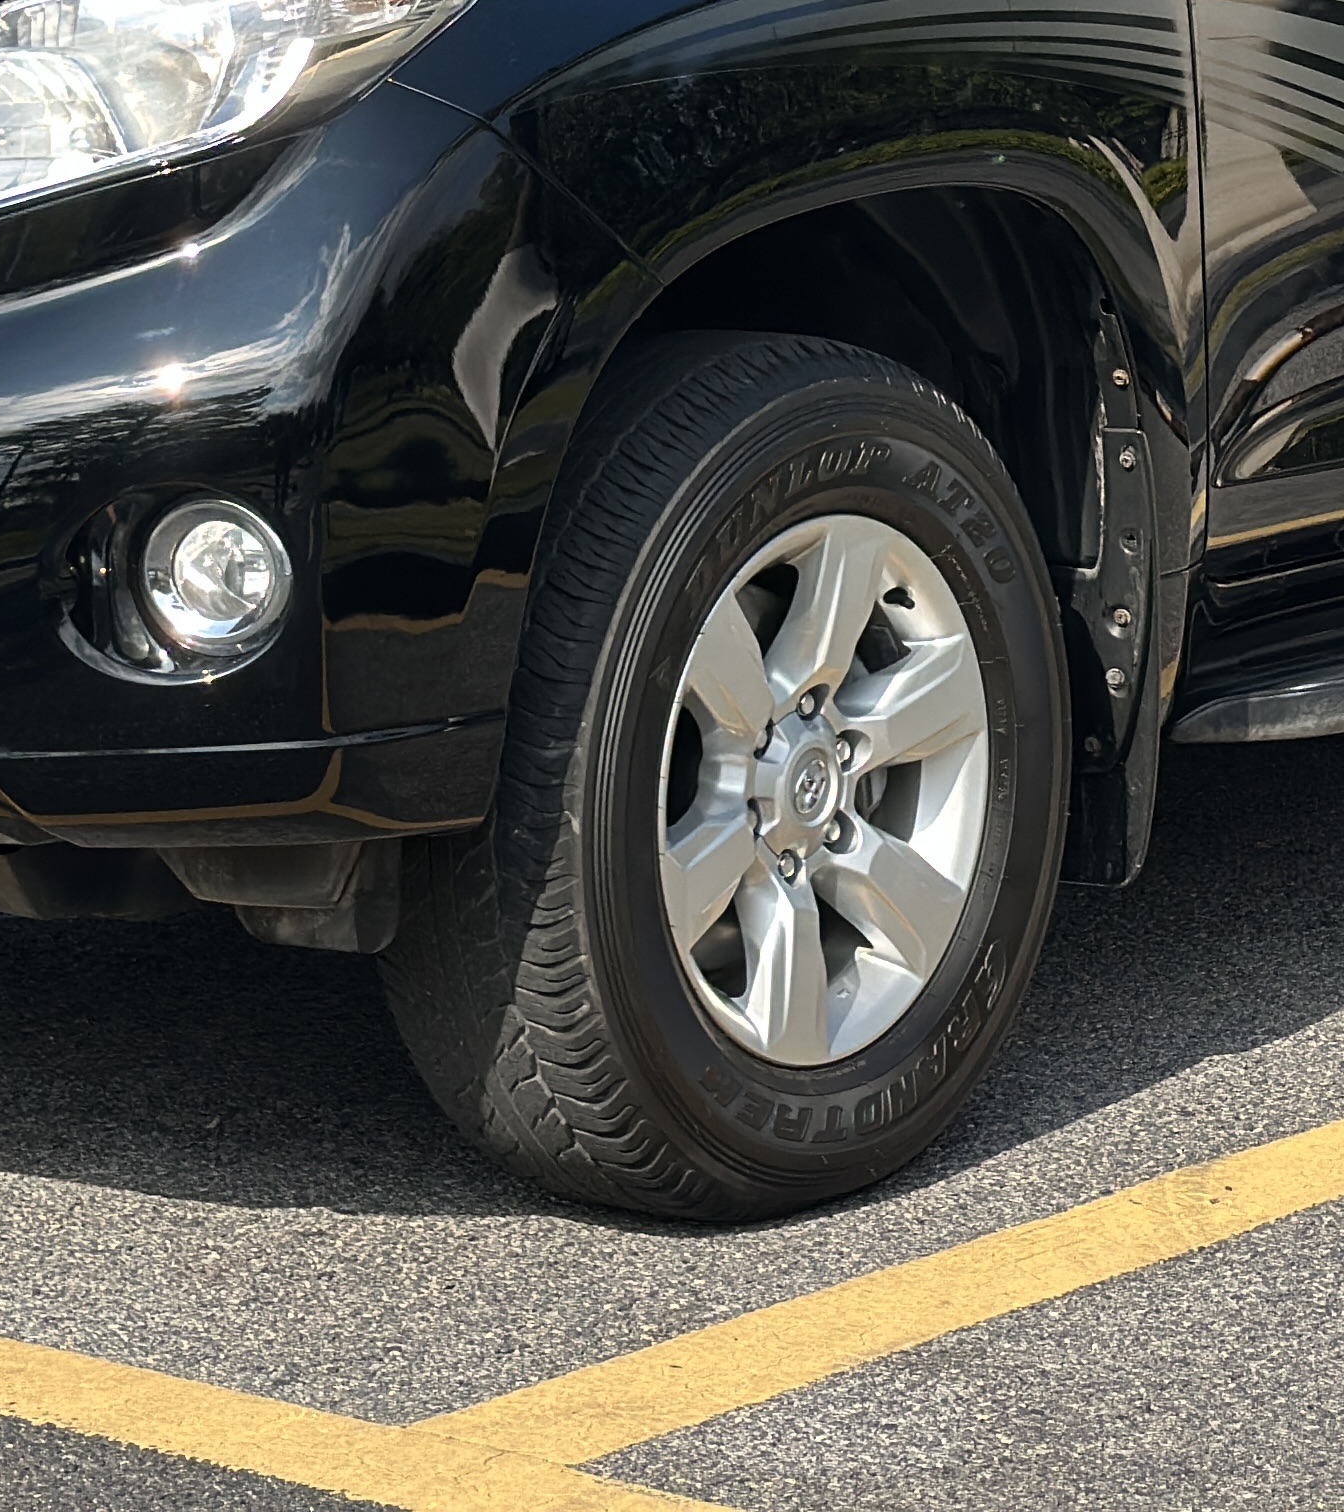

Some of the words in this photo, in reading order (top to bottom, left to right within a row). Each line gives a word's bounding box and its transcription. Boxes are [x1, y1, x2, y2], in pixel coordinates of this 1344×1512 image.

[684, 440, 892, 612] DUNLOP
[902, 460, 1016, 585] AT20
[699, 939, 1006, 1144] GRANDTREK
